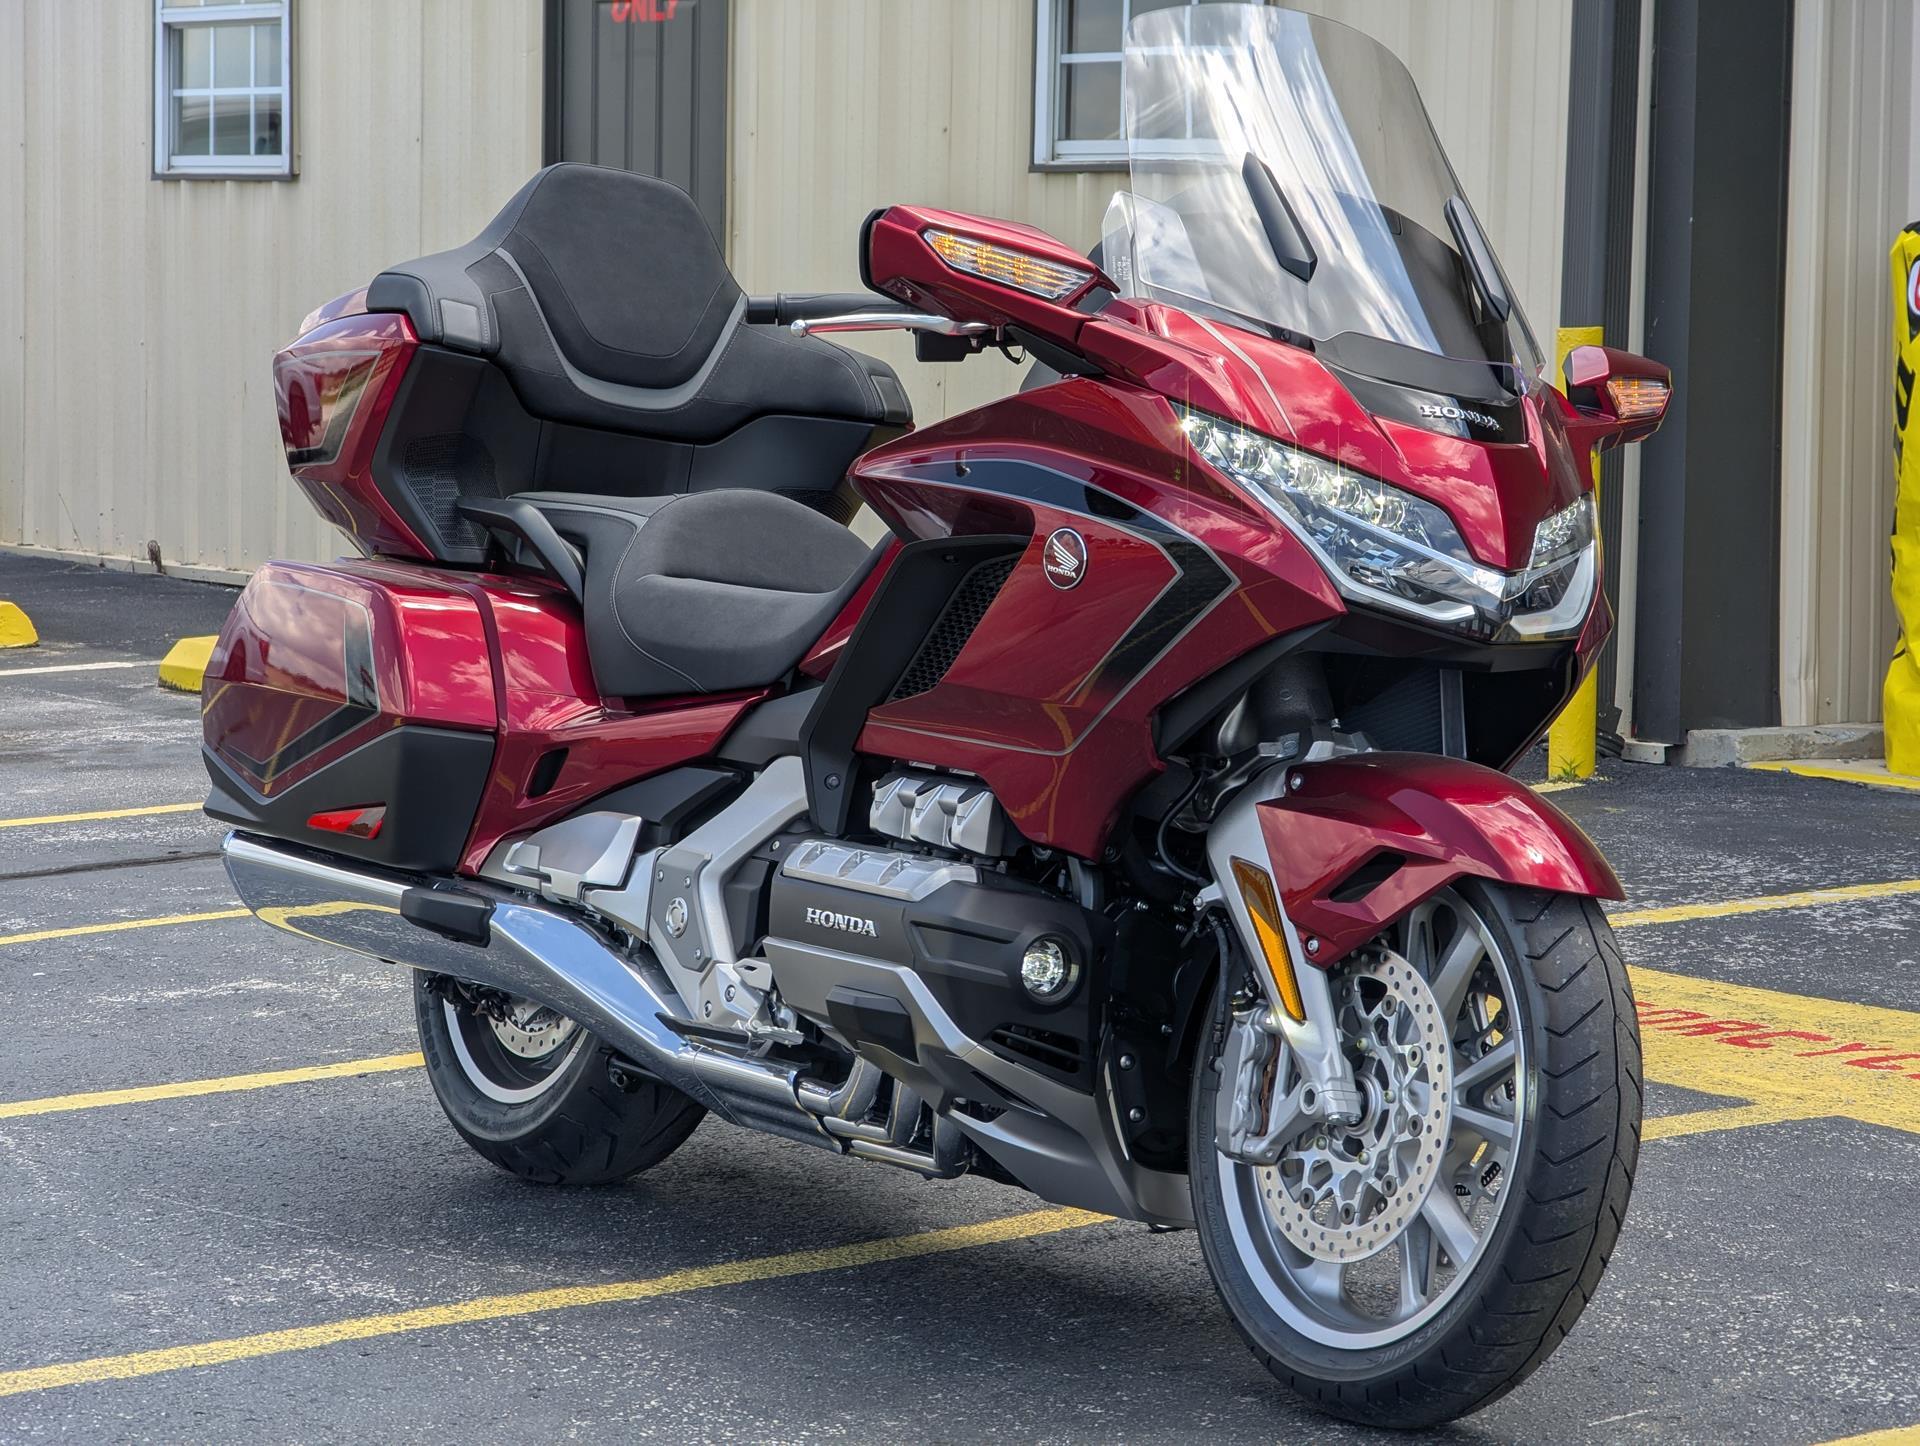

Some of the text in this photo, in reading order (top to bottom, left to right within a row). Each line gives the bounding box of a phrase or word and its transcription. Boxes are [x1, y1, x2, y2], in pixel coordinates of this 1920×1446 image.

[1420, 405, 1502, 431] HONDA
[1047, 565, 1077, 579] HONDA
[805, 907, 879, 938] HONDA
